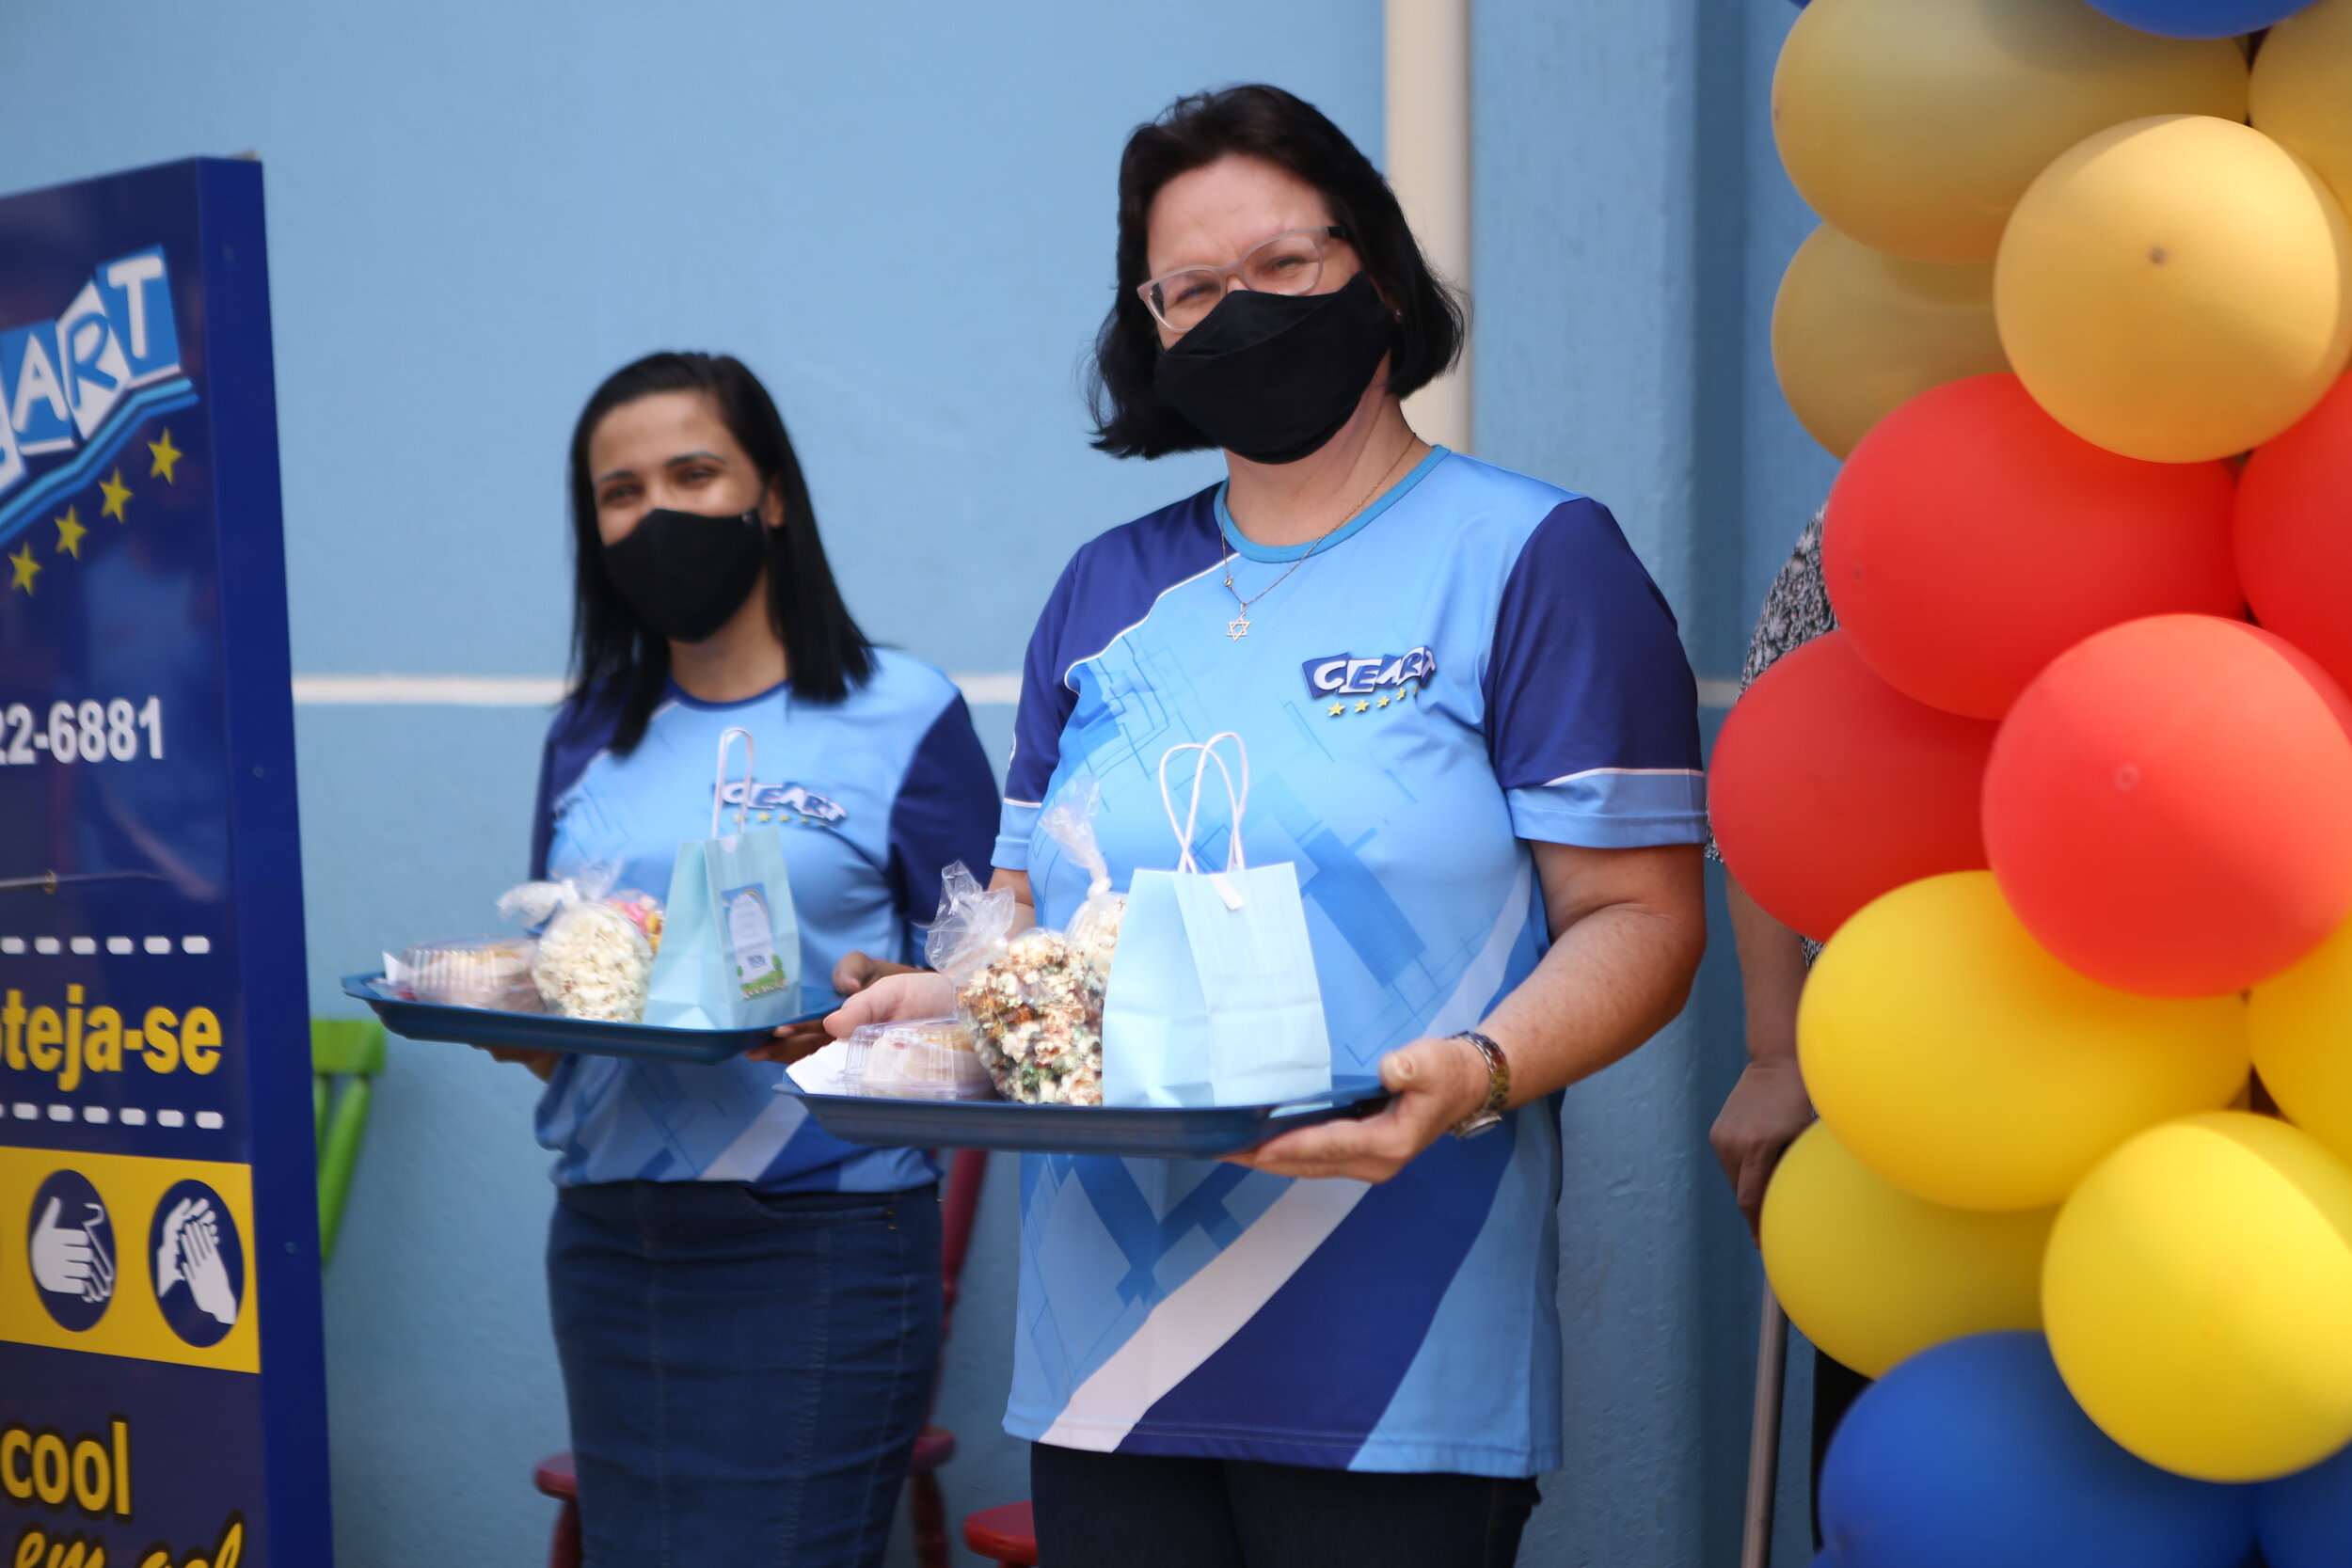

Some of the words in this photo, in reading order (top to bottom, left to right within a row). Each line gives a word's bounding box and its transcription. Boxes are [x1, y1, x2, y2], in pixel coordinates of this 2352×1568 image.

[0, 252, 165, 463] ART
[0, 696, 164, 766] 2-6881
[0, 983, 223, 1092] teja-se
